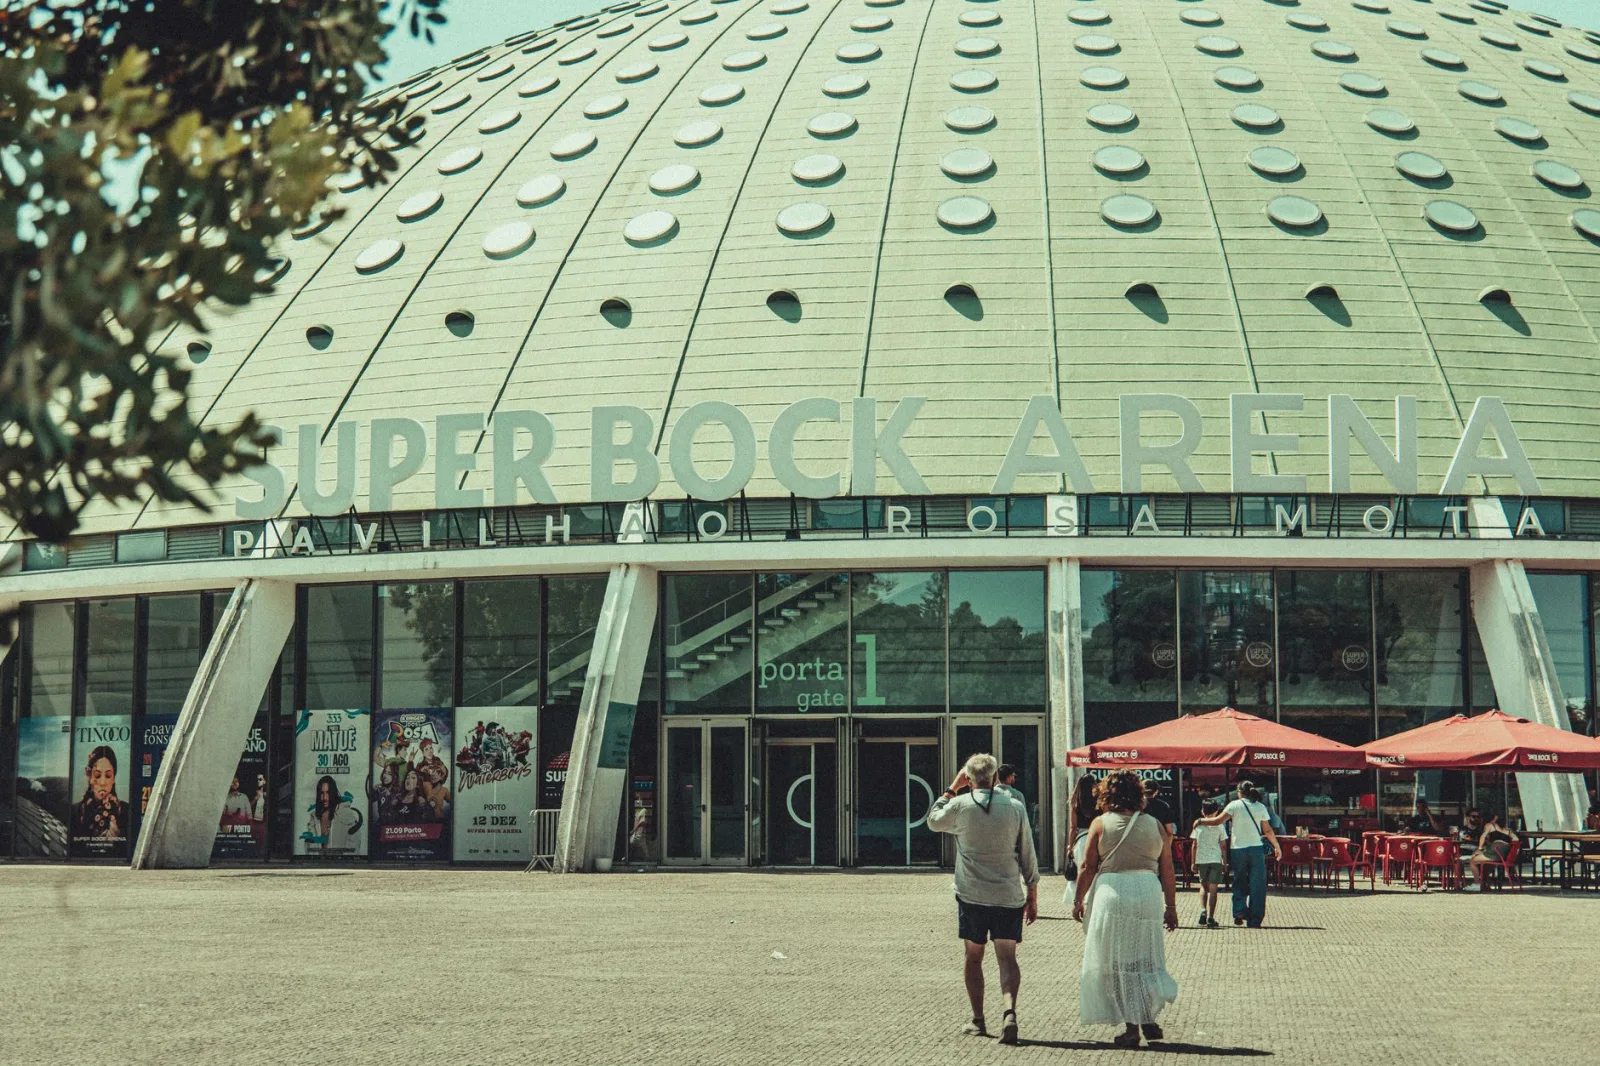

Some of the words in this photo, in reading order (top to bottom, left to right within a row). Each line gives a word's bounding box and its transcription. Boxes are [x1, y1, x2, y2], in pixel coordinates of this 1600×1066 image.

[235, 407, 559, 519] SUPER
[591, 397, 932, 501] BOCK
[990, 393, 1543, 495] ARENA
[233, 505, 728, 558] PAVILHÃO
[887, 505, 1160, 536] ROSA
[1275, 504, 1548, 536] MOTA
[759, 657, 844, 688] porta
[855, 633, 886, 706] 1
[797, 689, 845, 713] gate
[77, 726, 131, 742] TINOCO
[317, 753, 329, 767] 30
[332, 753, 349, 767] AGO
[472, 816, 487, 826] 12
[491, 816, 517, 826] DEZ
